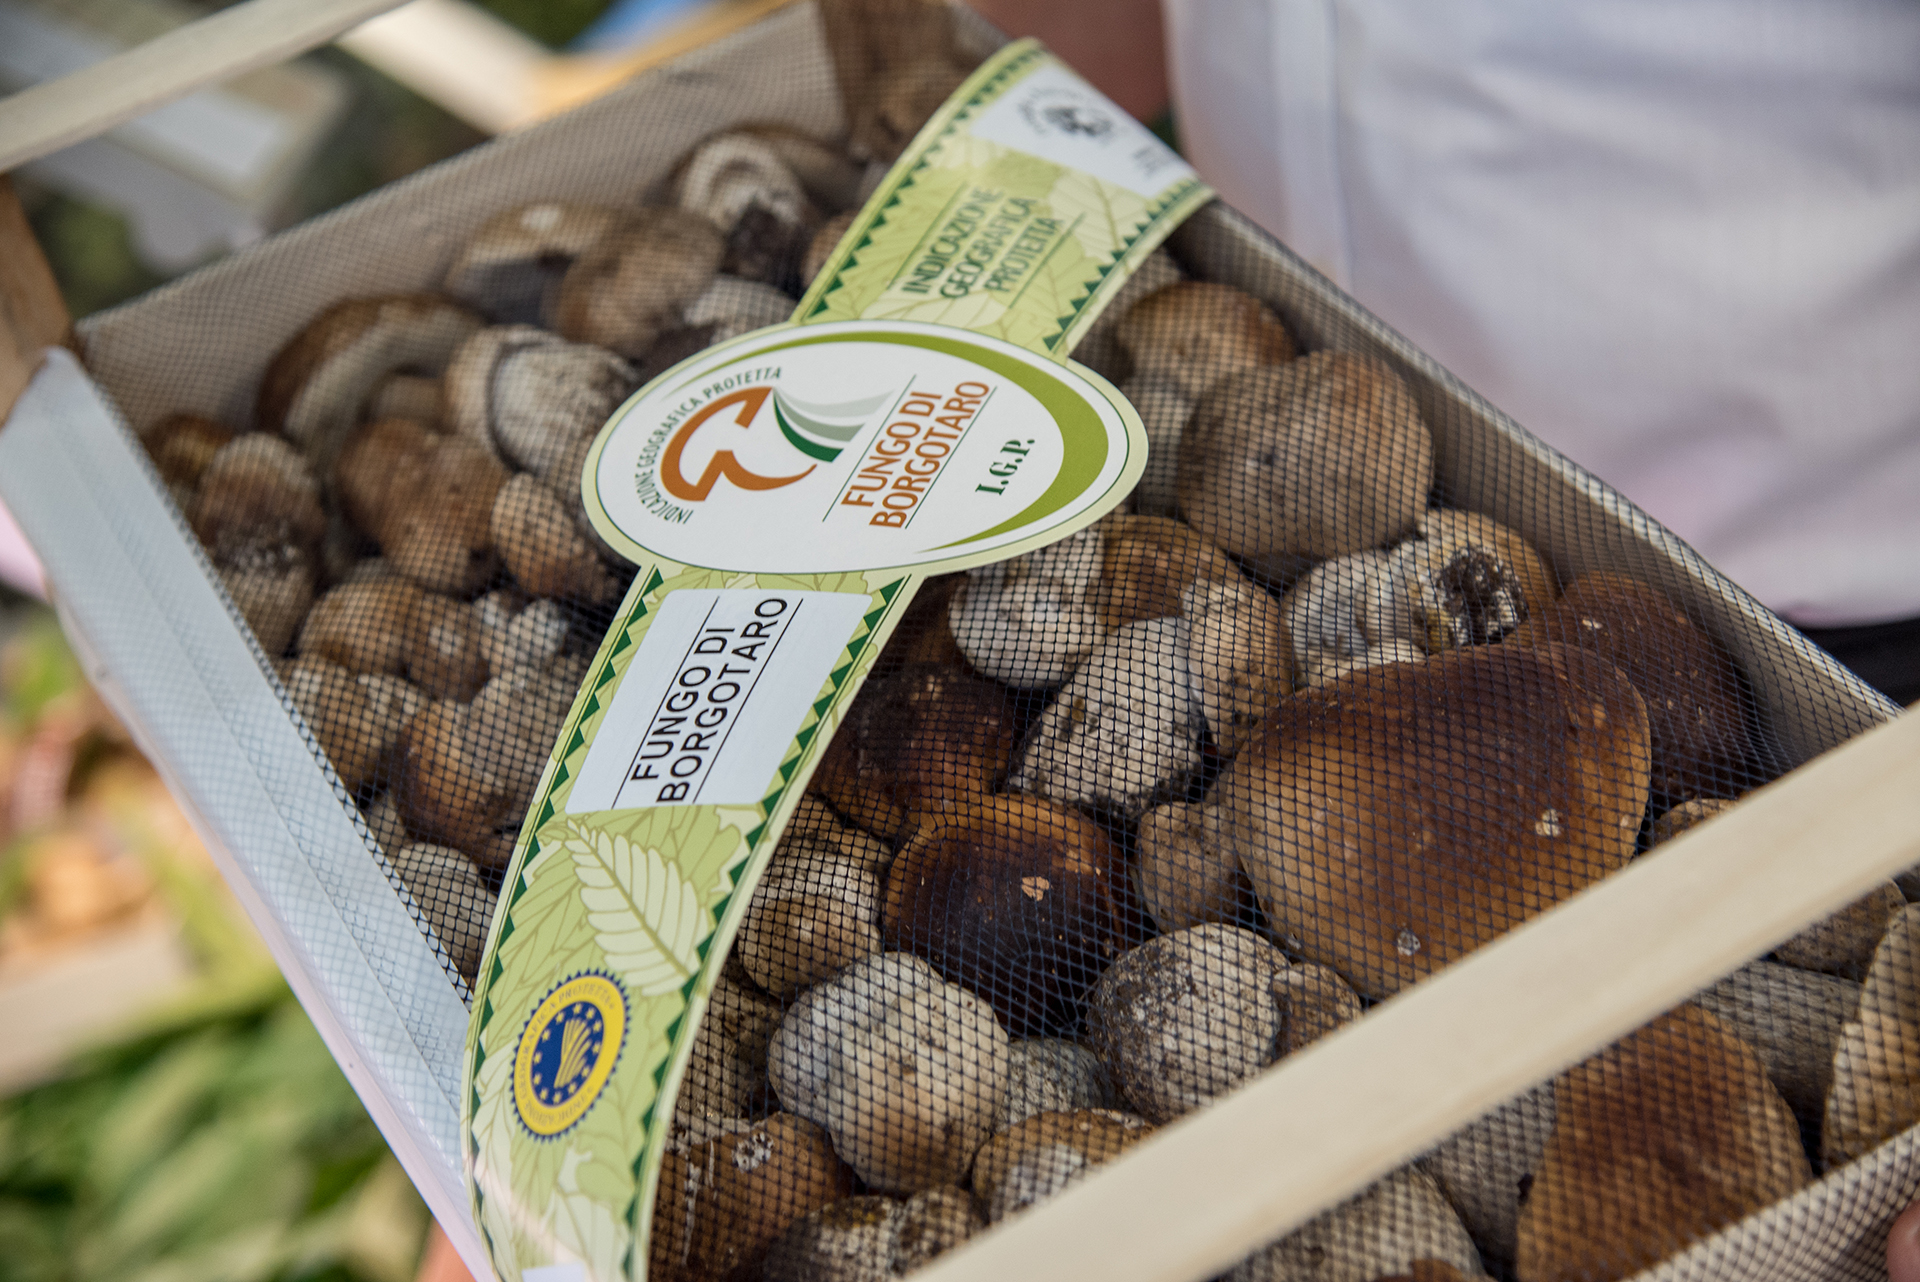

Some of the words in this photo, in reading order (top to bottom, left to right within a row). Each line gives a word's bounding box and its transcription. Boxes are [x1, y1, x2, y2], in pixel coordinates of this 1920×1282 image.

[902, 186, 1004, 294] INDICAZIONE
[940, 197, 1037, 299] GEOGRAFICA
[983, 217, 1065, 292] PROTETTA
[637, 397, 703, 468] GEOGRAFICA
[702, 366, 782, 399] PROTETTA
[634, 468, 694, 524] INDICAZIONE
[841, 421, 921, 507] FUNGO
[898, 391, 942, 417] DI
[869, 381, 990, 529] BORGOTARO
[975, 439, 1035, 495] I.G.P.
[630, 666, 711, 781] FUNGO
[693, 627, 735, 655] DI
[656, 598, 788, 803] BORGOTARO
